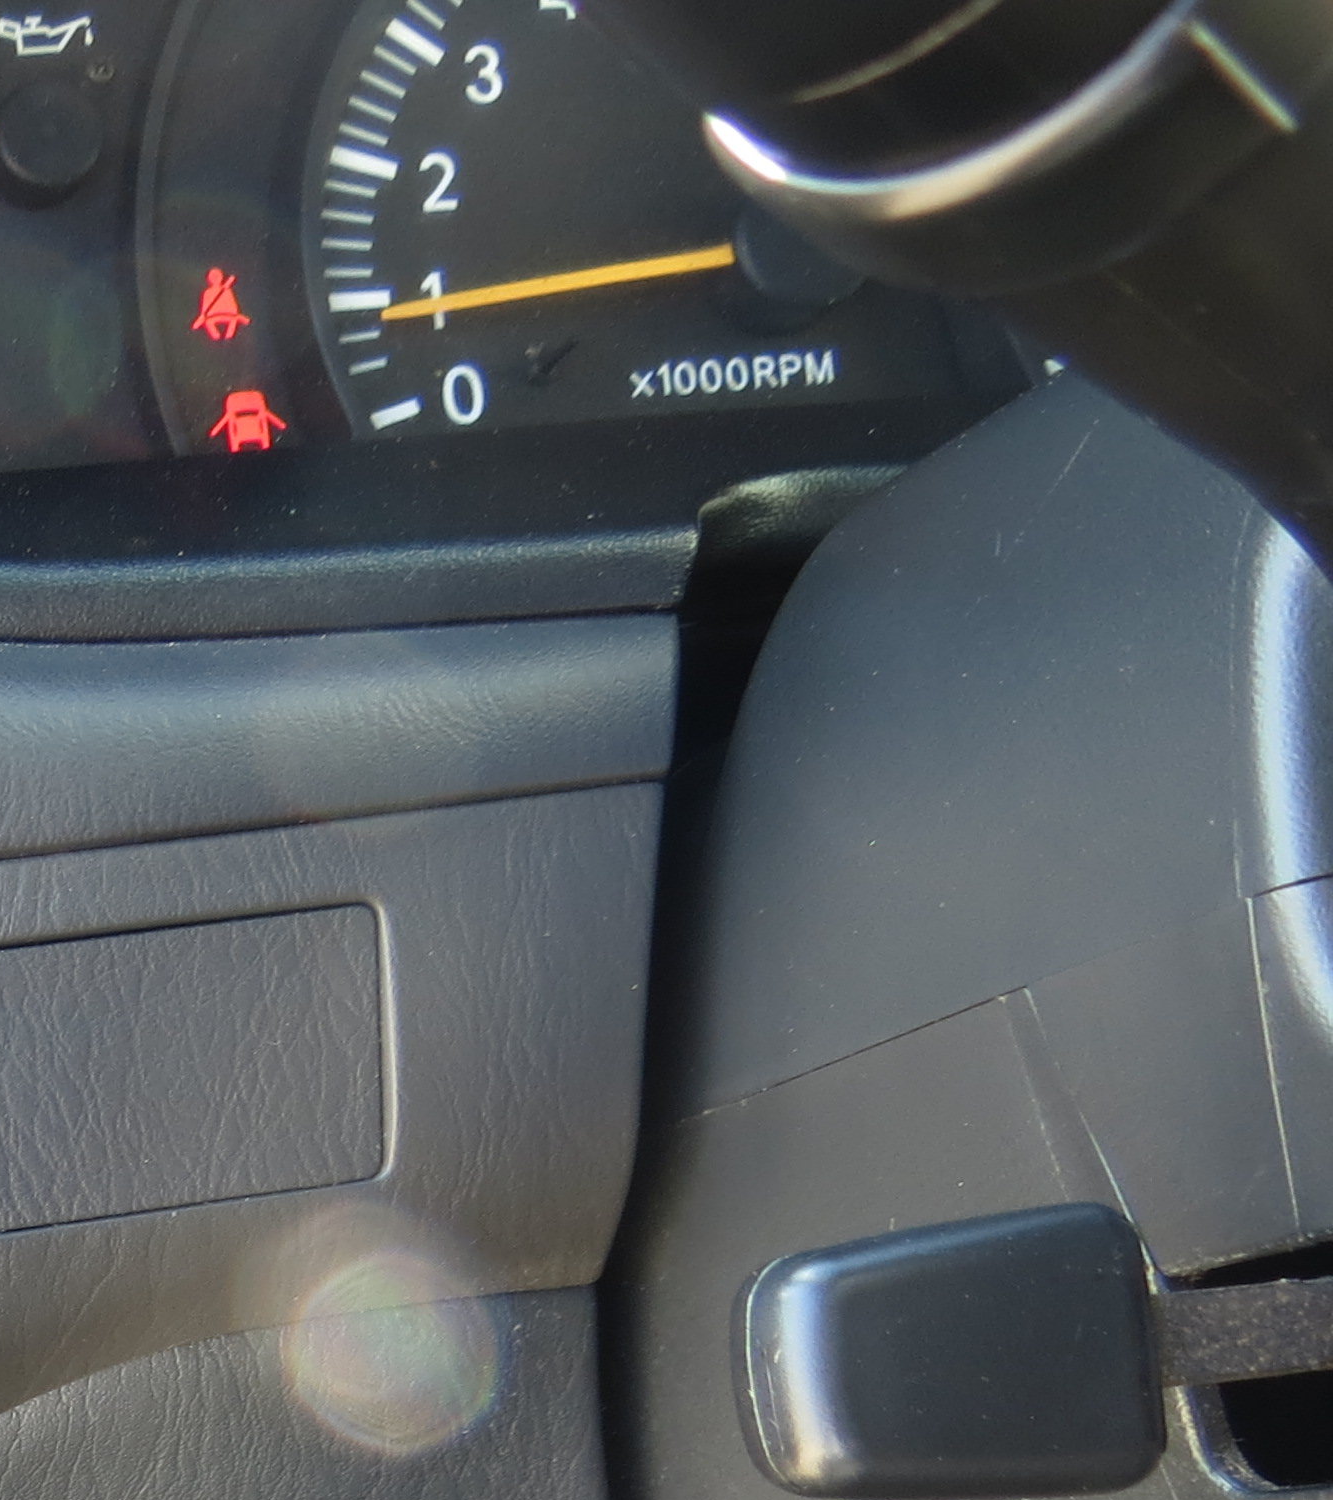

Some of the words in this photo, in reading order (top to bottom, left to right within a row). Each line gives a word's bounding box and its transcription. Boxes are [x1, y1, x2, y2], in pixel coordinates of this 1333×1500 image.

[464, 44, 504, 105] 3
[419, 152, 459, 212] 2
[419, 271, 447, 331] 1
[442, 364, 485, 426] 0
